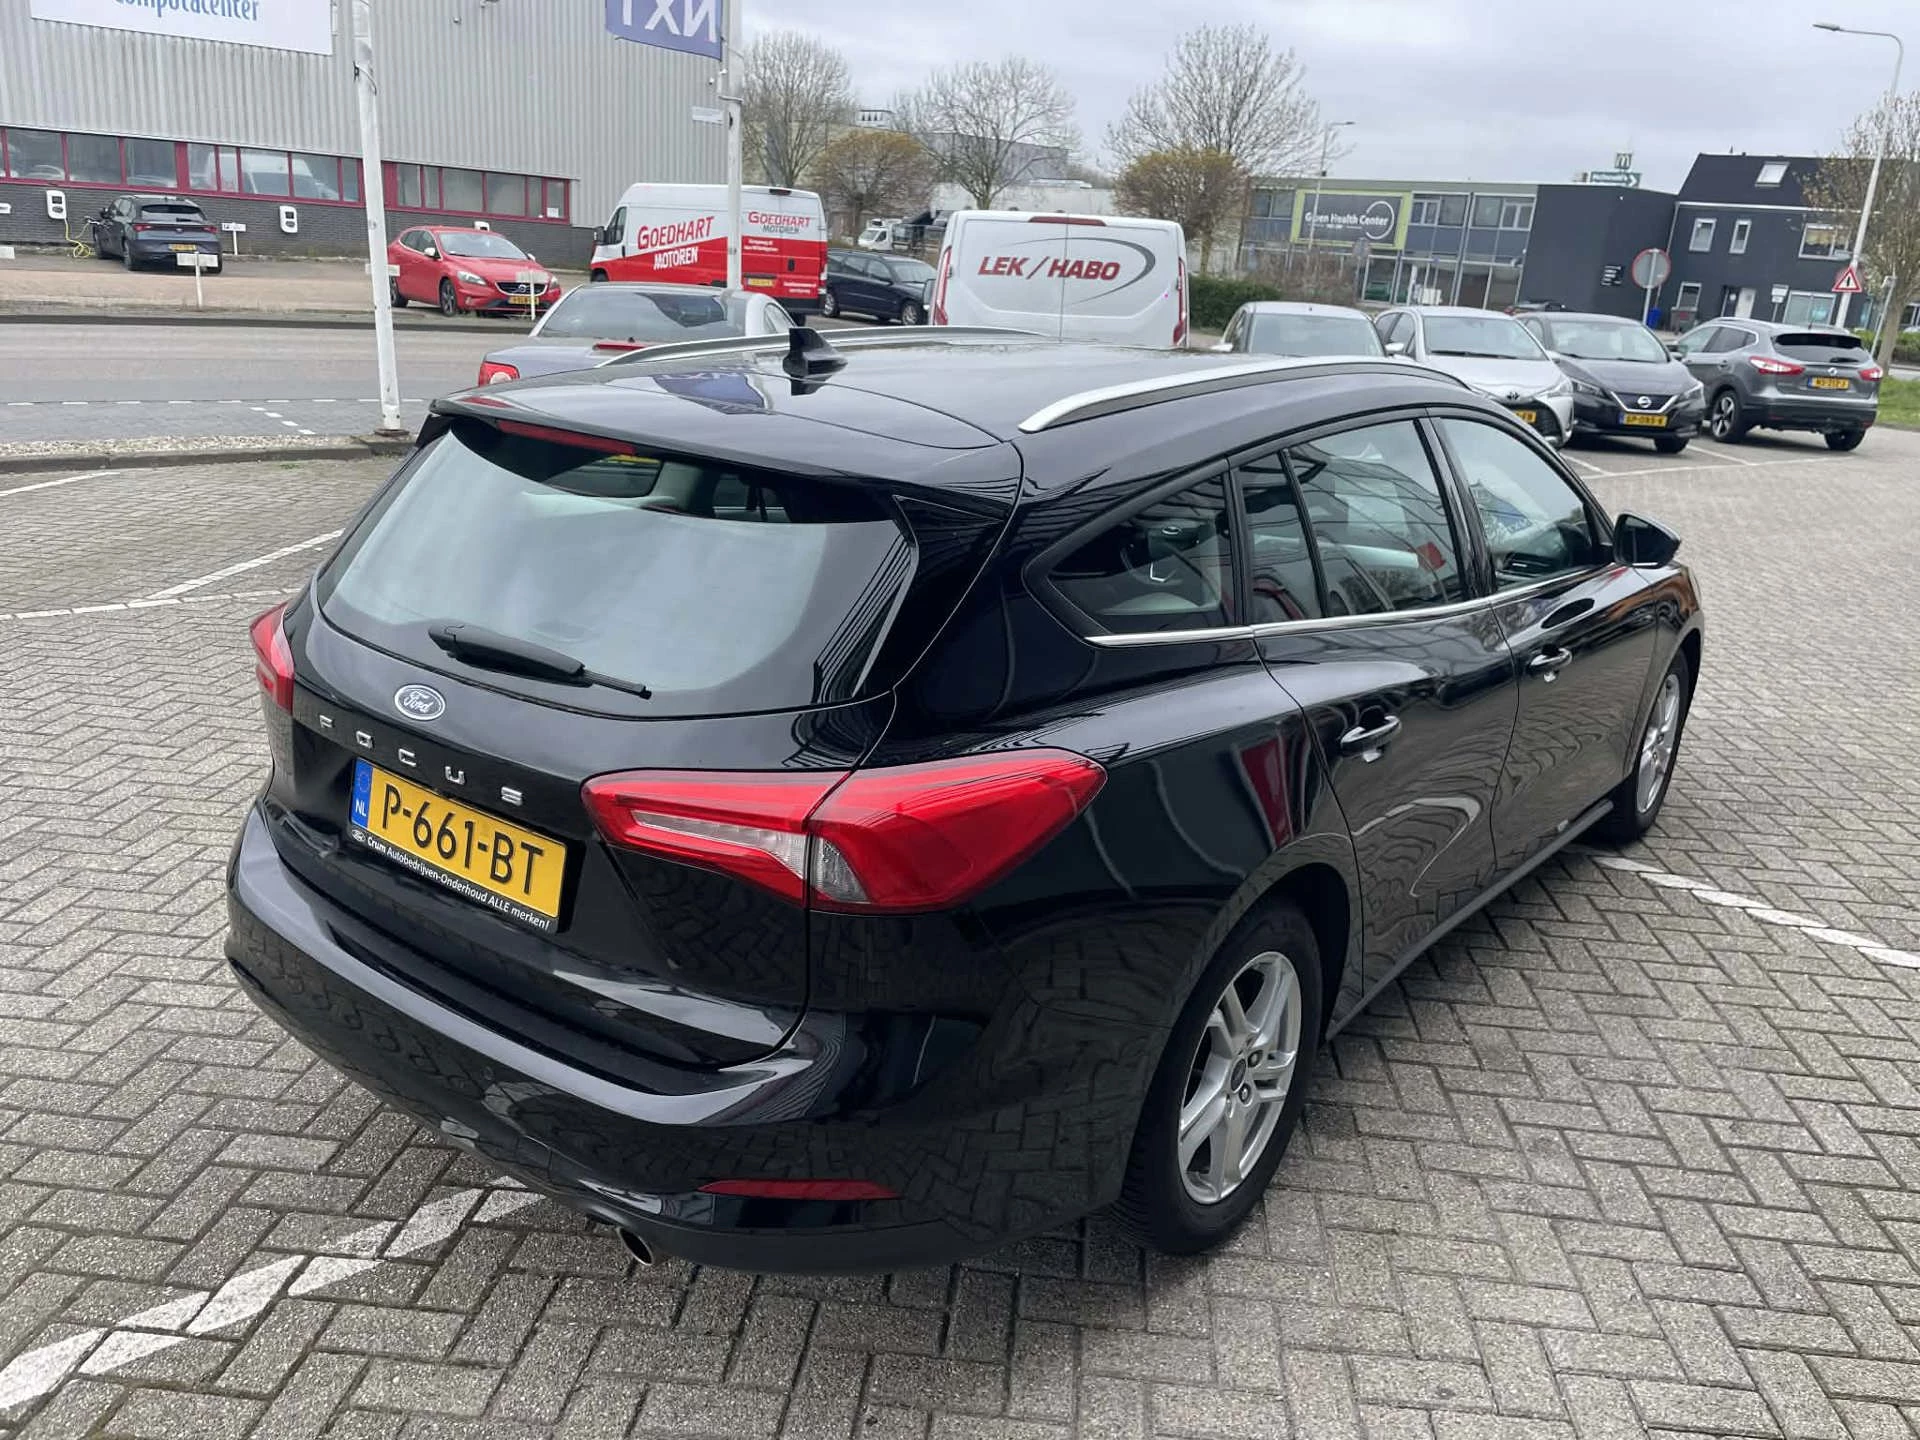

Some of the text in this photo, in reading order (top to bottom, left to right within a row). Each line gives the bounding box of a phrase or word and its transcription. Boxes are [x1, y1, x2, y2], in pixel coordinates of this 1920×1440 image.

[115, 0, 258, 20] putacenter
[748, 211, 811, 228] GOEDHART
[1304, 212, 1330, 223] Geen
[637, 215, 715, 250] GOEDHART
[653, 246, 699, 271] MOTOREN
[978, 256, 1030, 277] LEK
[1047, 258, 1122, 282] HABO
[403, 690, 434, 713] Ford
[319, 714, 523, 807] FOCUS
[355, 799, 367, 818] NL
[381, 783, 544, 896] P-661-BT
[367, 836, 551, 931] Crum Autobedrijven-Onderhoud ALLE merken!
